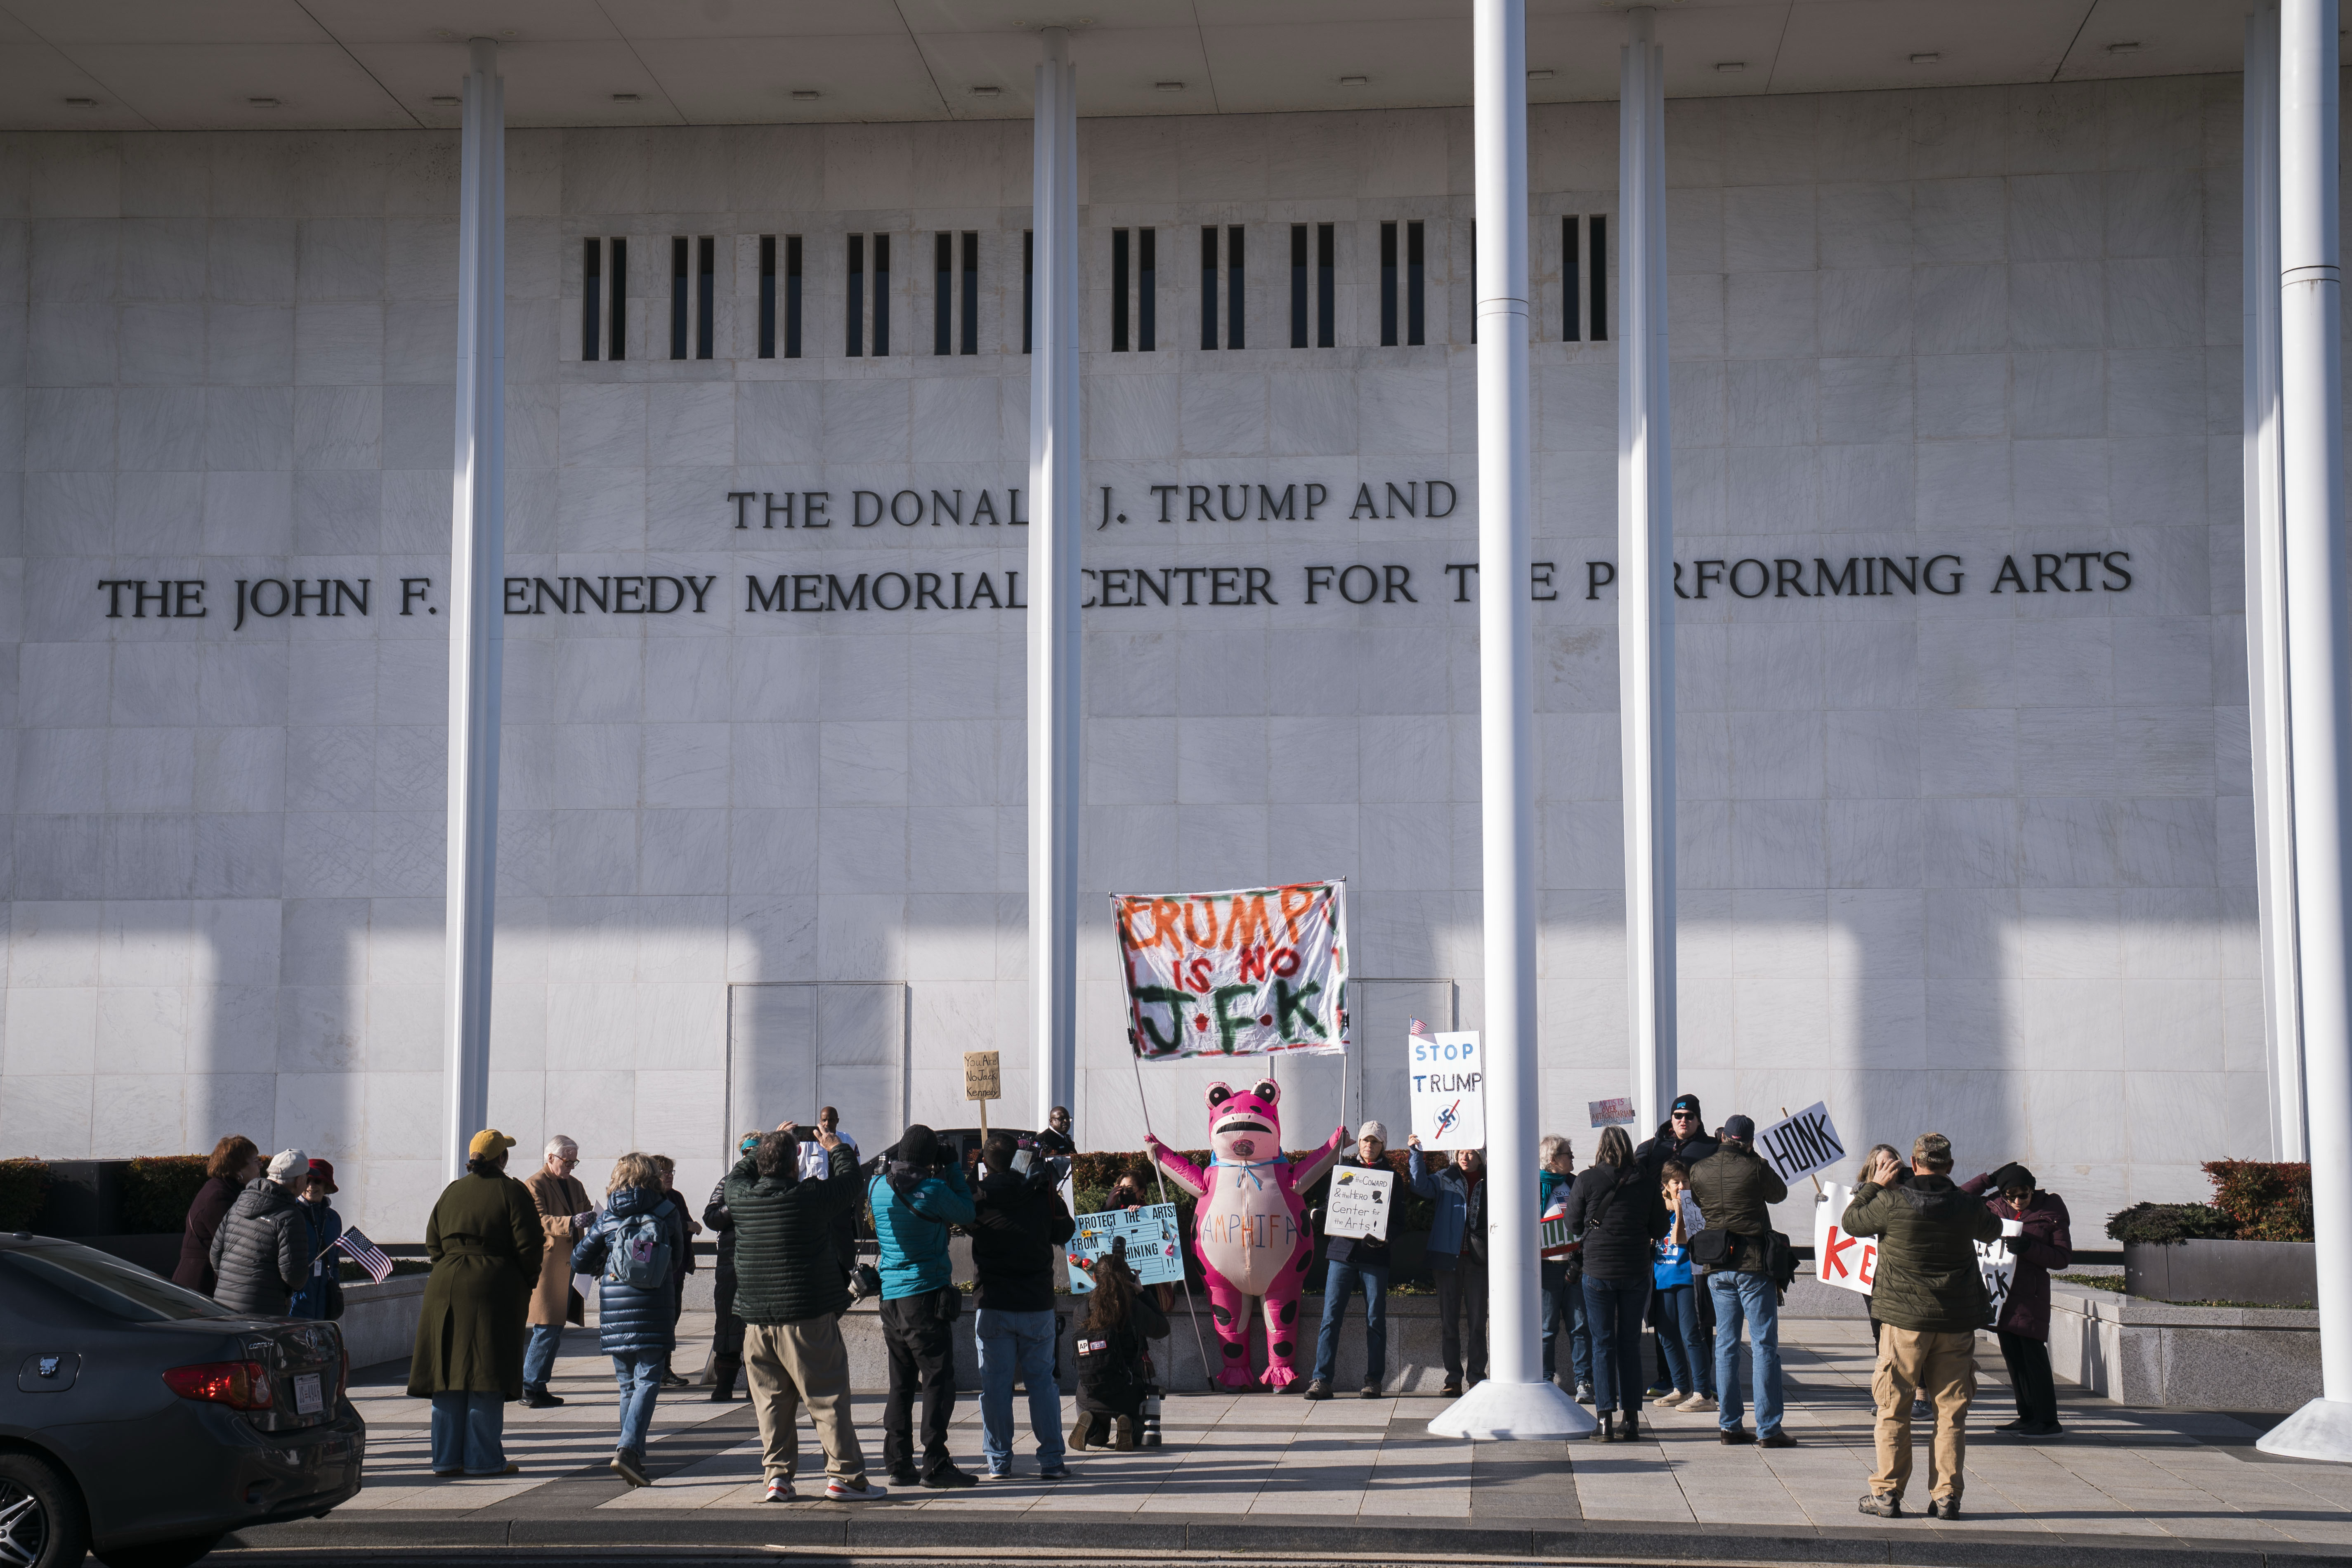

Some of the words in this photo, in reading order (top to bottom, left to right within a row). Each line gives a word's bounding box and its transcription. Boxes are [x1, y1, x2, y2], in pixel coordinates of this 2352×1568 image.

[727, 491, 830, 529] THE
[852, 489, 1029, 527] DONAL
[1097, 486, 1127, 531] J.
[1150, 483, 1327, 522] TRUMP
[1349, 481, 1457, 519] AND
[97, 579, 207, 618] THE
[233, 579, 371, 631] JOHN
[400, 578, 437, 616] F.
[504, 576, 716, 615] ENNEDY
[746, 571, 1027, 612] MEMORIAL
[1304, 564, 1418, 605] FOR
[1445, 562, 1557, 602] TE
[1586, 554, 1965, 600] PFORMING
[1990, 551, 2132, 594] ARTS
[1173, 958, 1213, 993] IS
[1240, 946, 1301, 983] NO
[964, 1056, 981, 1067] You
[982, 1054, 997, 1066] Are
[1415, 1044, 1473, 1061] STOP
[966, 1070, 977, 1082] No
[978, 1070, 997, 1081] Jack
[1412, 1072, 1482, 1093] TRUMP
[966, 1086, 998, 1098] Kennedy
[1599, 1098, 1625, 1108] ARTISTS
[1762, 1112, 1844, 1181] HONK
[1334, 1188, 1341, 1197] &
[1350, 1189, 1368, 1200] HERO
[1332, 1202, 1370, 1216] Center
[1078, 1214, 1116, 1230] PROTECT
[1124, 1210, 1141, 1223] THE
[1152, 1205, 1176, 1220] ARTS!
[1202, 1214, 1303, 1249] AMPHIFA
[1071, 1236, 1099, 1251] FROM
[1125, 1243, 1159, 1259] HINING
